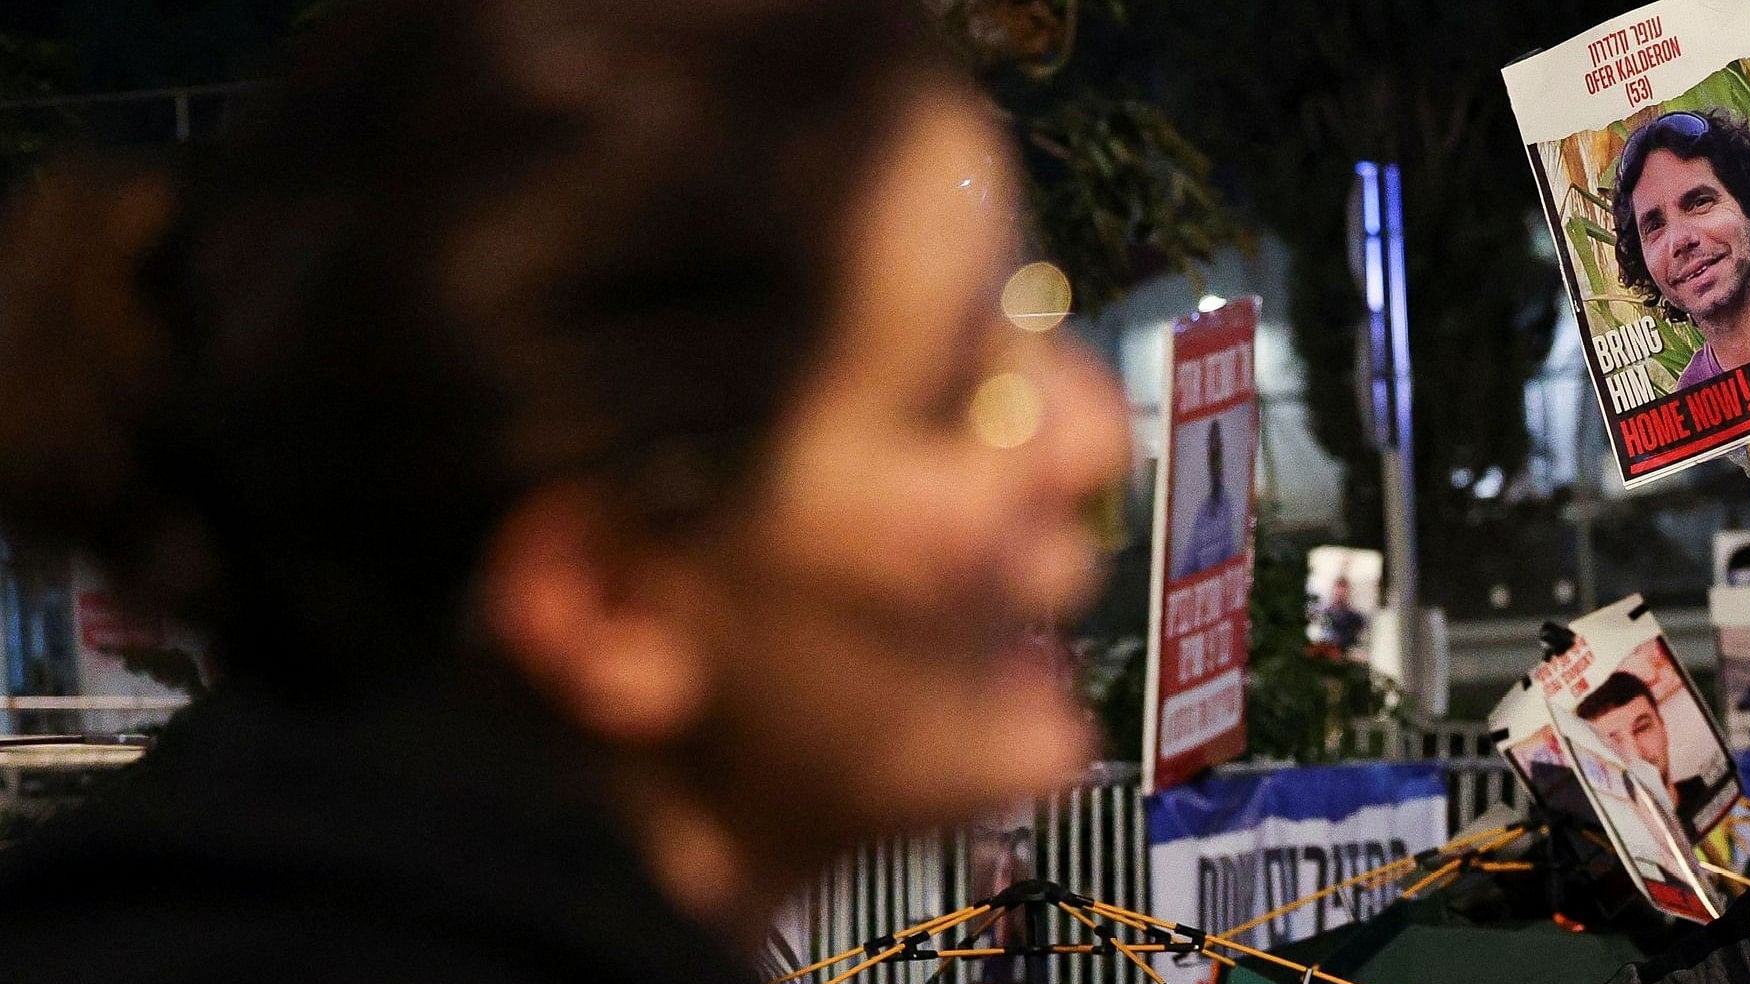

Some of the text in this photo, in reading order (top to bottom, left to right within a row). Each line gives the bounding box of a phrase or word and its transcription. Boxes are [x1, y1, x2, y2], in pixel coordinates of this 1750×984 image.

[1584, 35, 1681, 95] OFER KALDERON
[1587, 15, 1663, 68] עופר קלדרון
[1625, 74, 1654, 108] (53)
[1591, 316, 1663, 374] BRING
[1605, 363, 1656, 415] HIM
[1619, 401, 1691, 459] HOME
